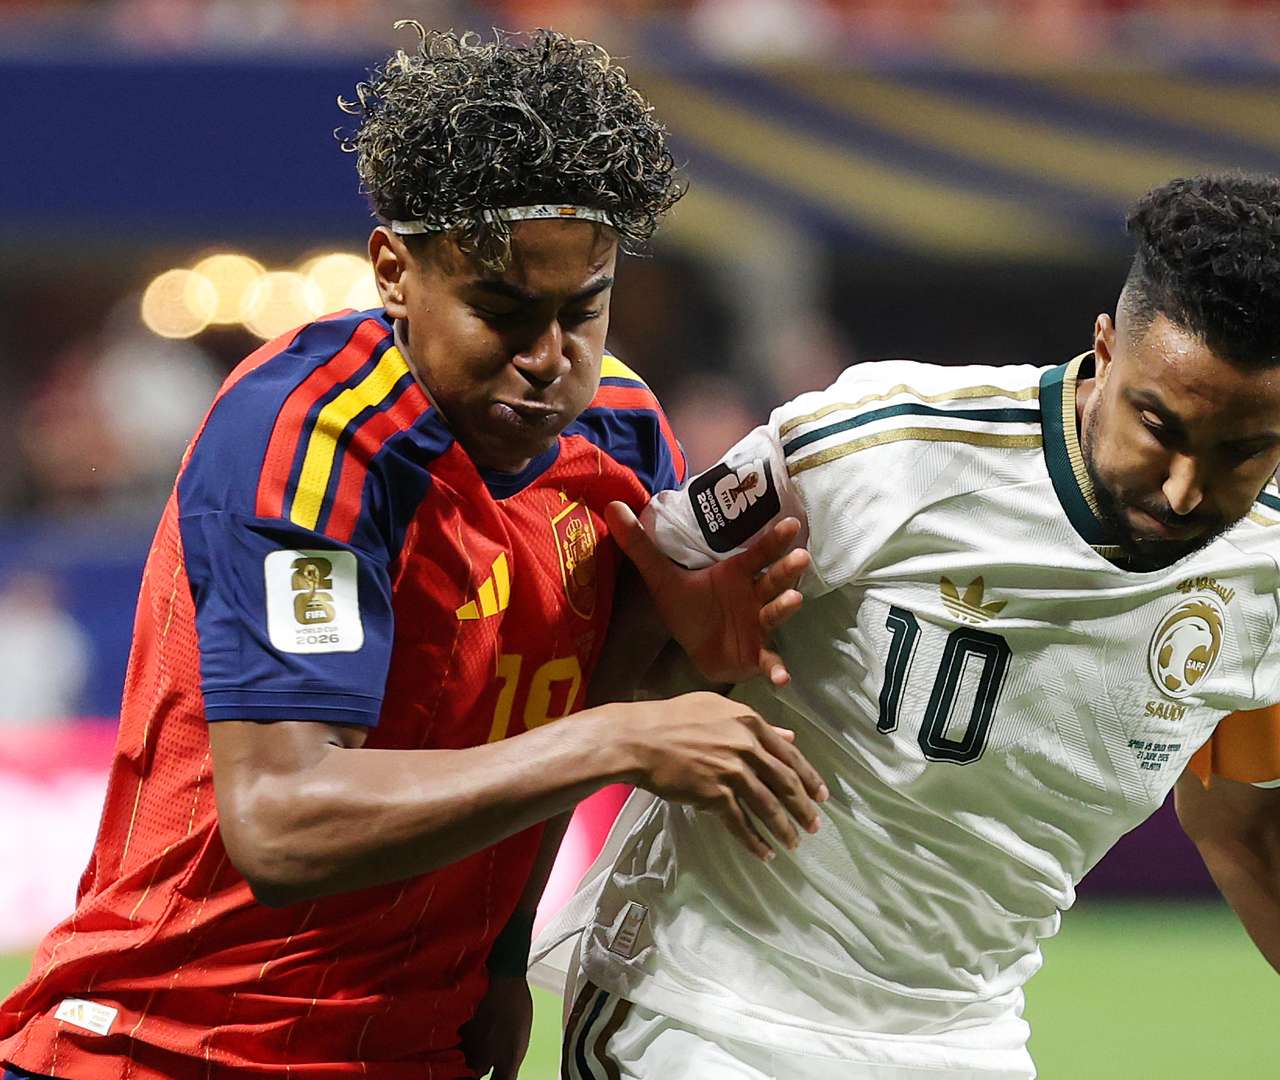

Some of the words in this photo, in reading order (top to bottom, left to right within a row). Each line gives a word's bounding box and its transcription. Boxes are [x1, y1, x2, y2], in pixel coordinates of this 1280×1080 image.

[697, 492, 719, 532] 2026
[705, 488, 719, 513] WORLD
[715, 512, 726, 527] CUP
[296, 634, 340, 645] 2026
[876, 605, 1013, 765] 10
[1144, 702, 1186, 721] SAUDI
